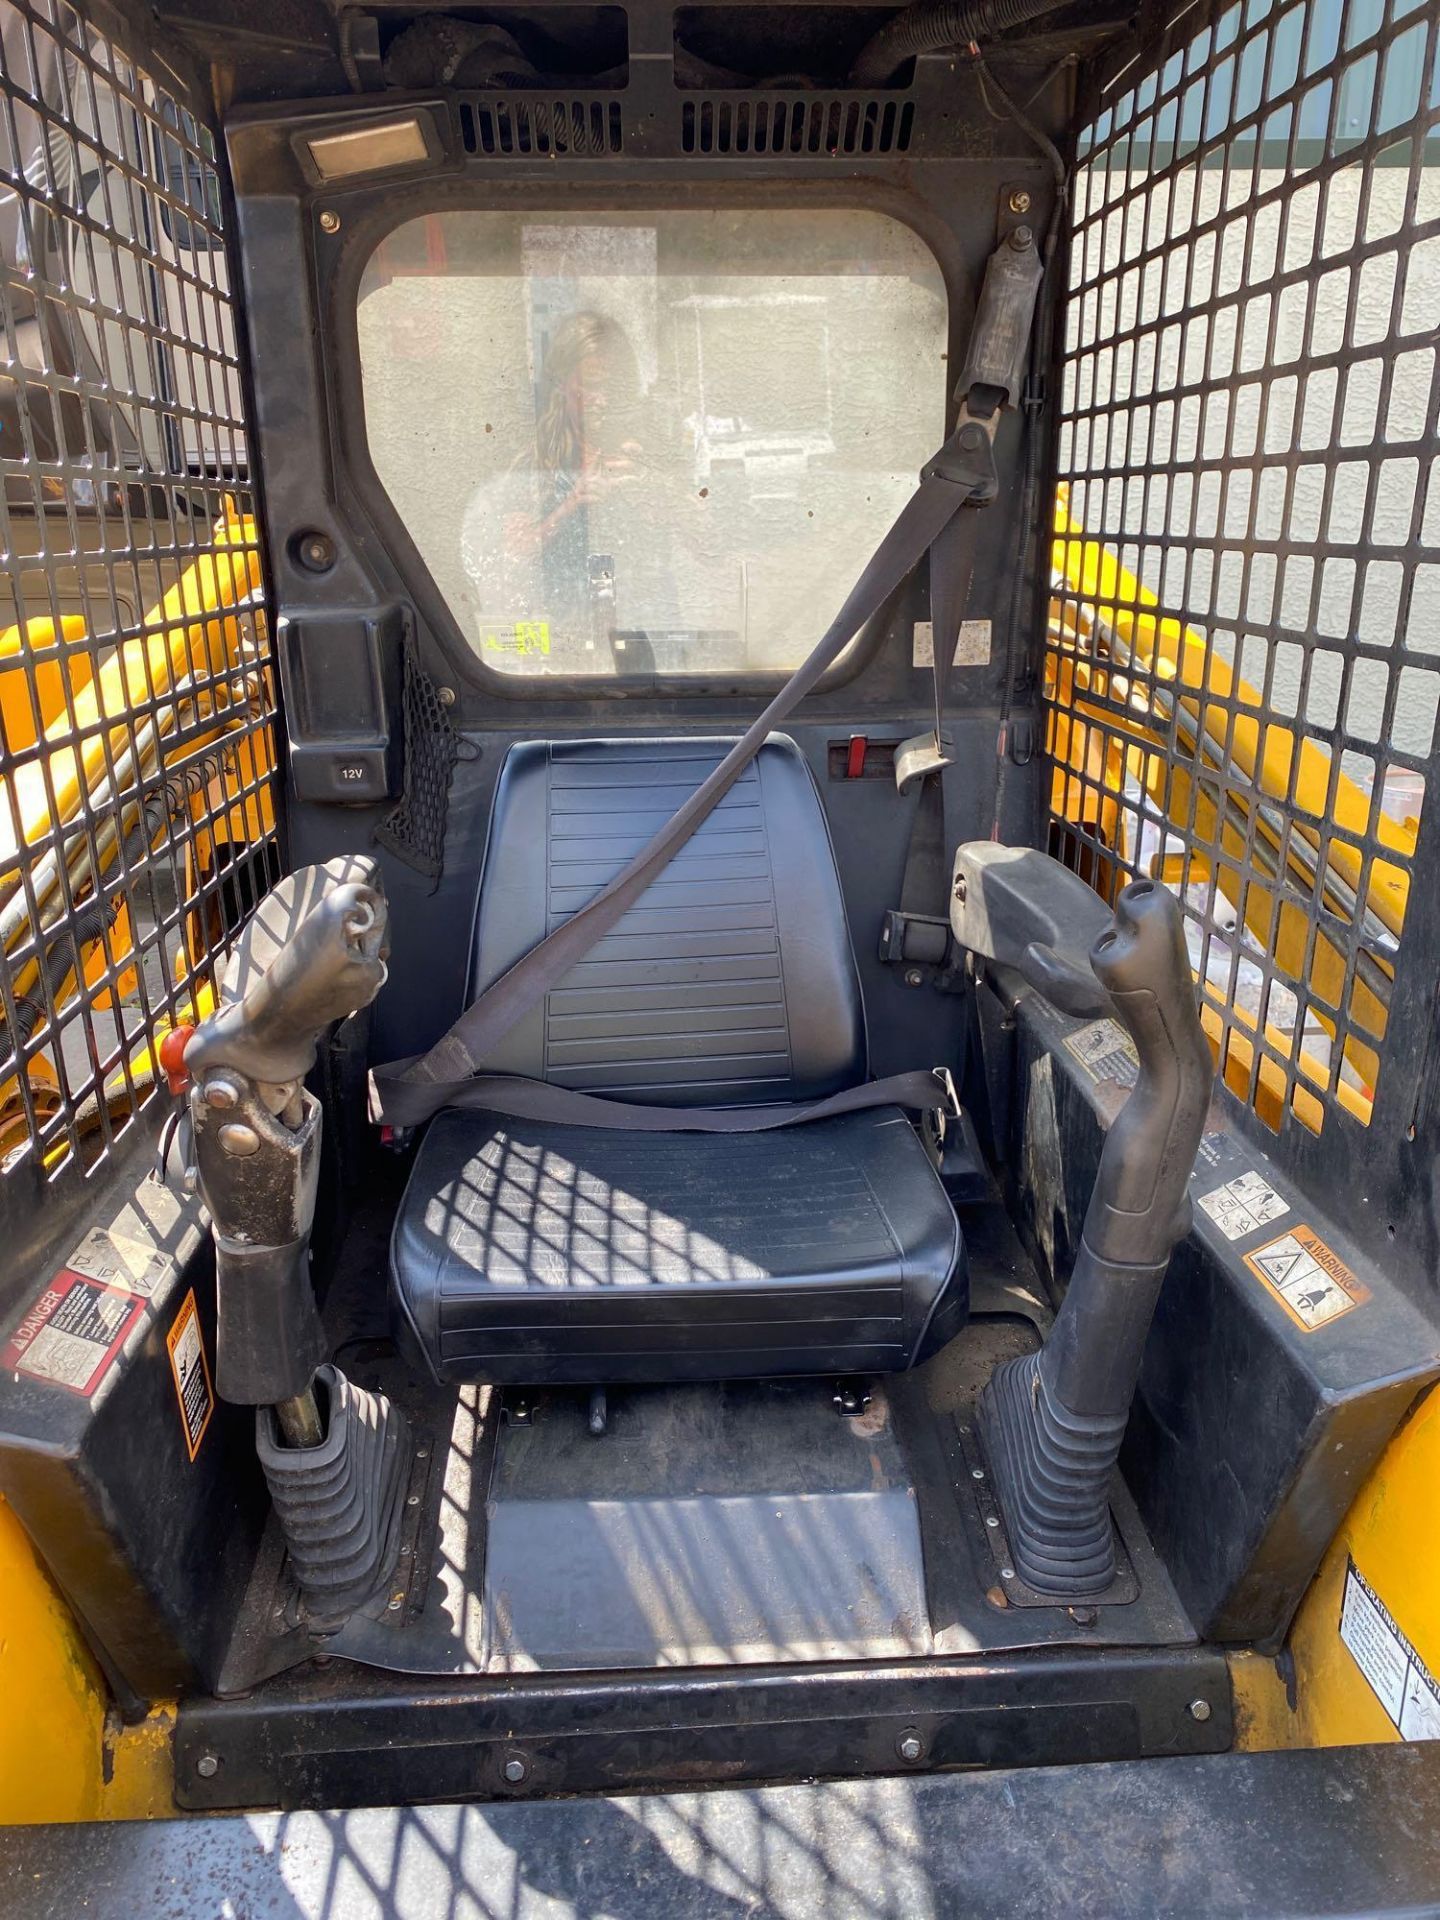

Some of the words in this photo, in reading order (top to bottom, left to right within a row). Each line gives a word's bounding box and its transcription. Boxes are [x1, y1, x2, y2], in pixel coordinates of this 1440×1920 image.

[342, 768, 363, 779] 12V
[1310, 1245, 1357, 1290] WARNING
[16, 1290, 63, 1340] DANGER
[1355, 1568, 1397, 1635] OPERATING
